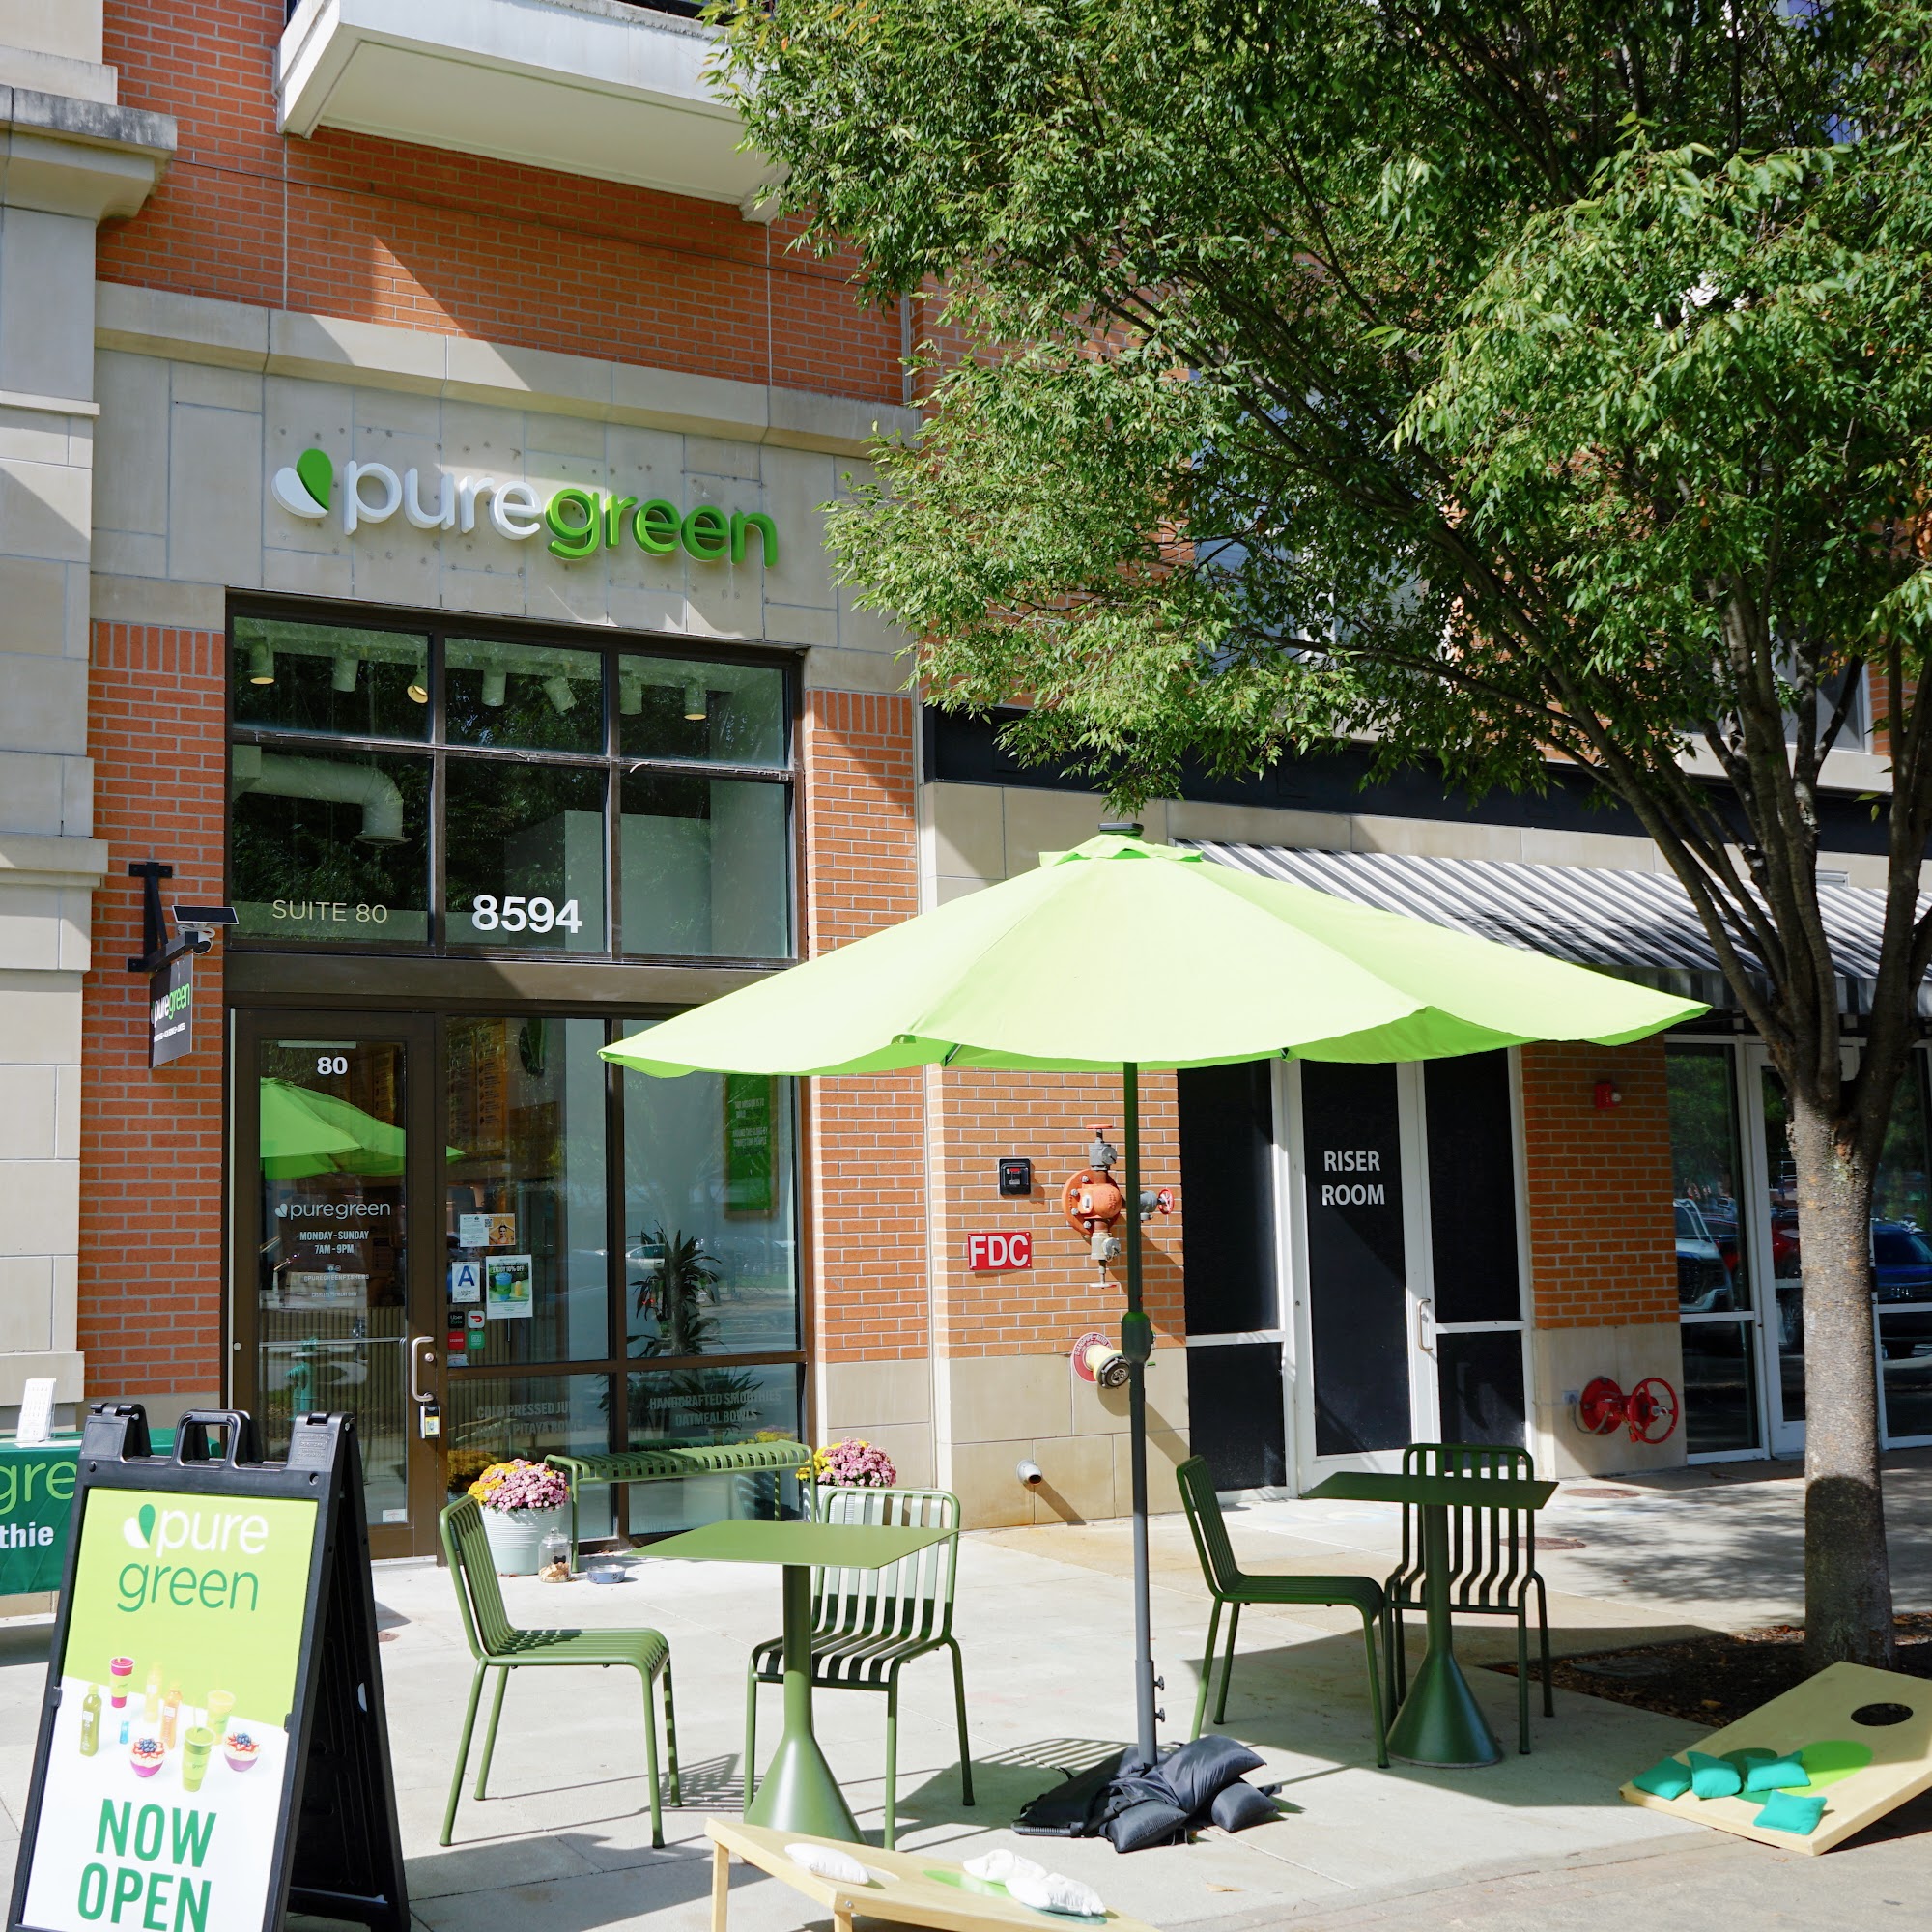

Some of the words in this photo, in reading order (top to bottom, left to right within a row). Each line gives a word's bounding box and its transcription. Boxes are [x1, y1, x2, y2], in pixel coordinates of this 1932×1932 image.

[272, 899, 347, 922] SUITE
[355, 903, 387, 923] 80
[471, 894, 582, 934] 8594
[317, 1056, 348, 1075] 80
[1323, 1151, 1381, 1172] RISER
[1321, 1184, 1385, 1206] ROOM
[970, 1234, 1029, 1267] FDC
[457, 1265, 475, 1286] A
[505, 1402, 554, 1417] PRESSED
[649, 1394, 724, 1410] HANDCRAFTED
[675, 1411, 724, 1427] OATMEAL
[724, 1408, 758, 1423] BOWLS
[156, 1509, 270, 1559] pure
[116, 1563, 259, 1613] green
[95, 1798, 217, 1868] NOW
[77, 1862, 213, 1932] OPEN
